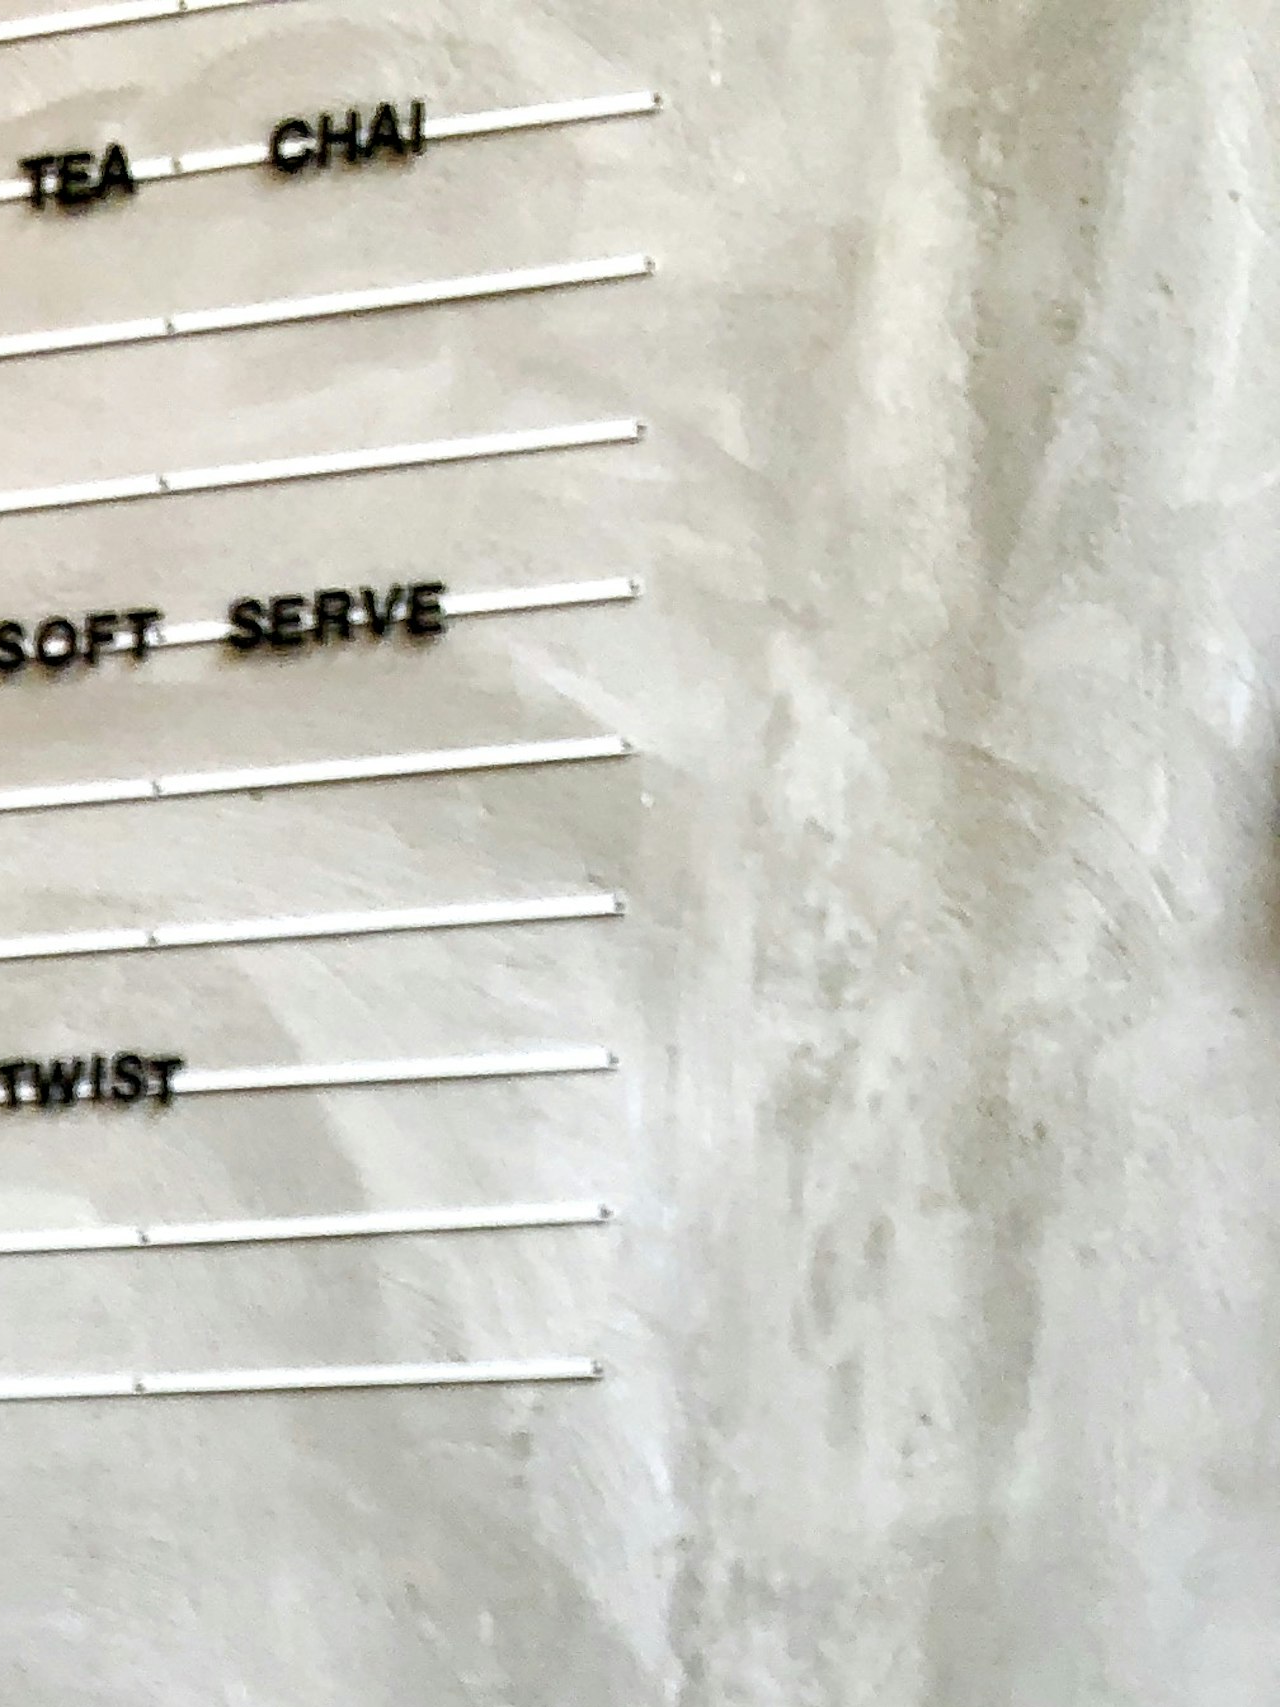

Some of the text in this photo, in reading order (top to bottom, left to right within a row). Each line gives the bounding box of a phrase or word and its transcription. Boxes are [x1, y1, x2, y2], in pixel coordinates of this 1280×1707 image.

[19, 142, 135, 207] TEA
[268, 97, 427, 171] CHAI
[229, 582, 447, 649] SERVE
